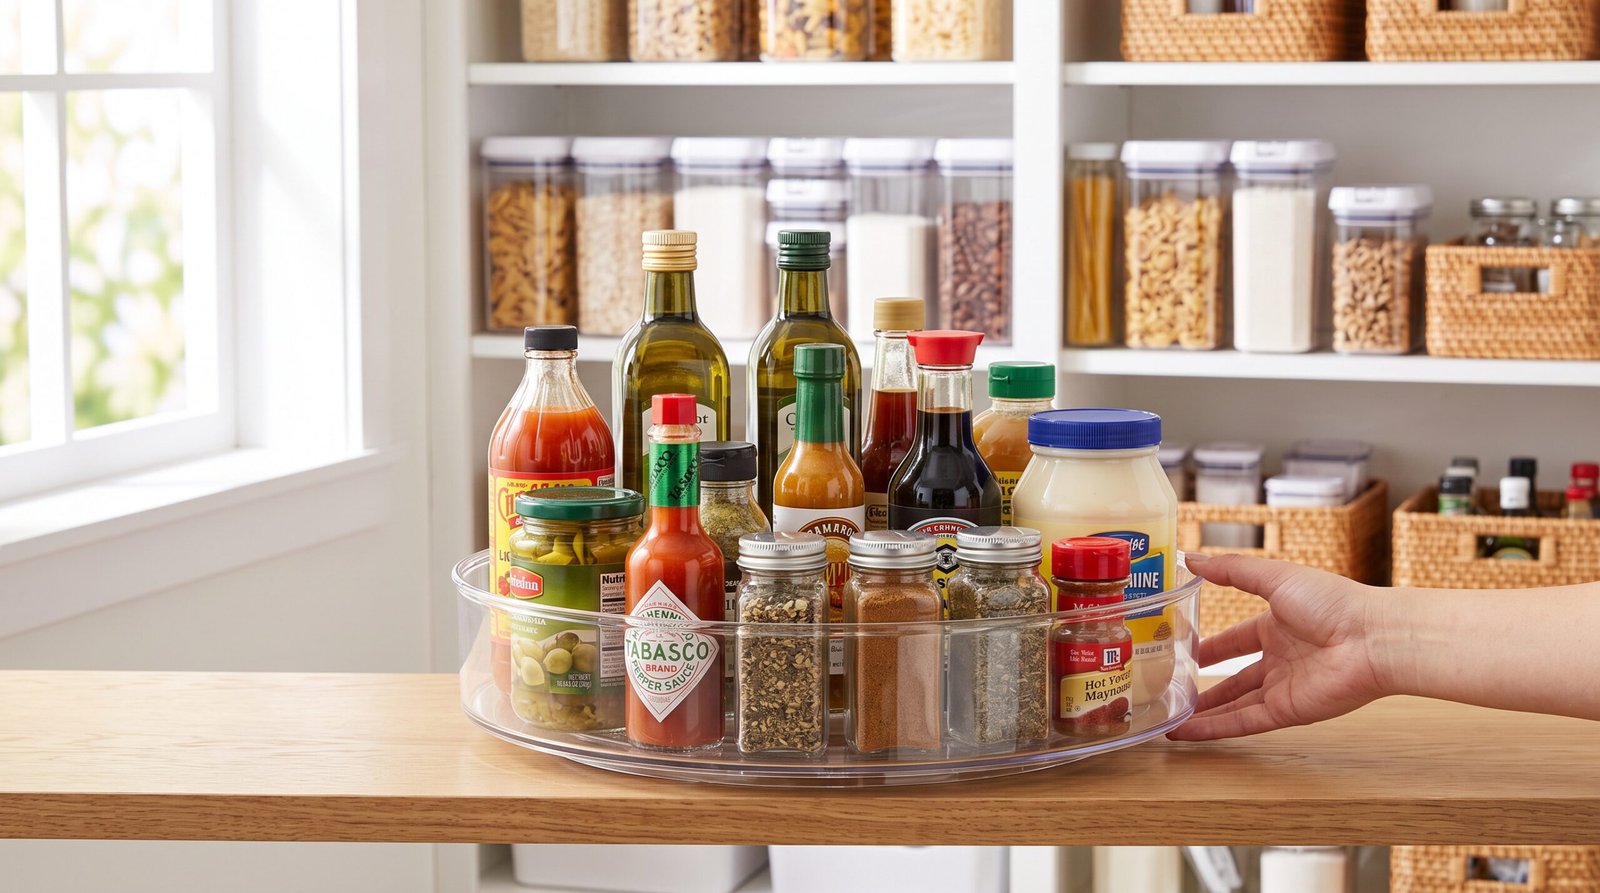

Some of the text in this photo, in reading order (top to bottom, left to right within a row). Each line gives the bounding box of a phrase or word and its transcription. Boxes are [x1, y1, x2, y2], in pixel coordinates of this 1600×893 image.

[626, 639, 709, 662] TABASCO
[631, 659, 662, 691] PEPPER
[664, 662, 695, 691] SAUCE
[645, 664, 678, 673] BRAND
[1085, 678, 1106, 691] Hot
